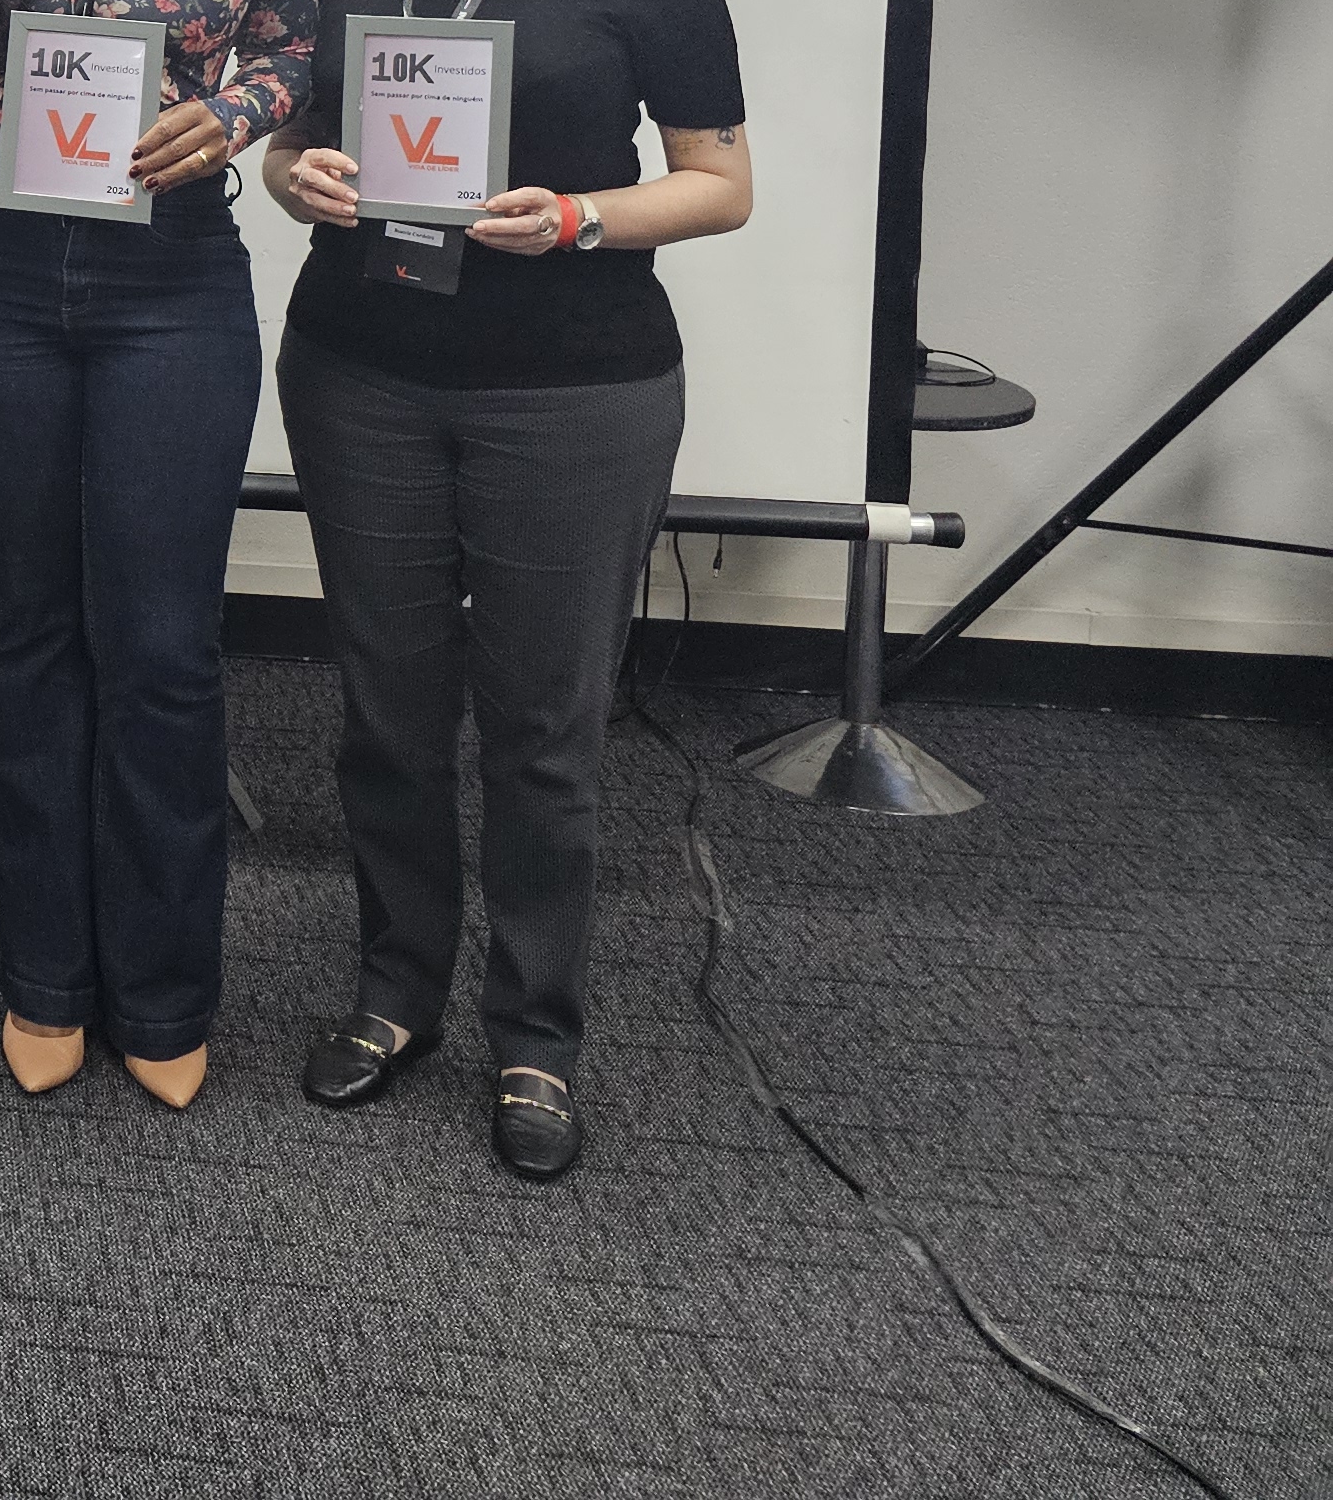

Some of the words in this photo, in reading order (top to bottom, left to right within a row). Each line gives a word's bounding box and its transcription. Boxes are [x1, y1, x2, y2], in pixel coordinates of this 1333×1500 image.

[30, 47, 92, 81] 10K
[91, 62, 139, 76] Investidos
[371, 52, 435, 84] 10K
[435, 65, 486, 76] Investidos
[45, 87, 66, 95] passar
[107, 93, 135, 101] ninguém
[46, 109, 110, 161] VL
[390, 114, 459, 166] VL
[107, 186, 129, 195] 2024
[457, 191, 481, 200] 2024
